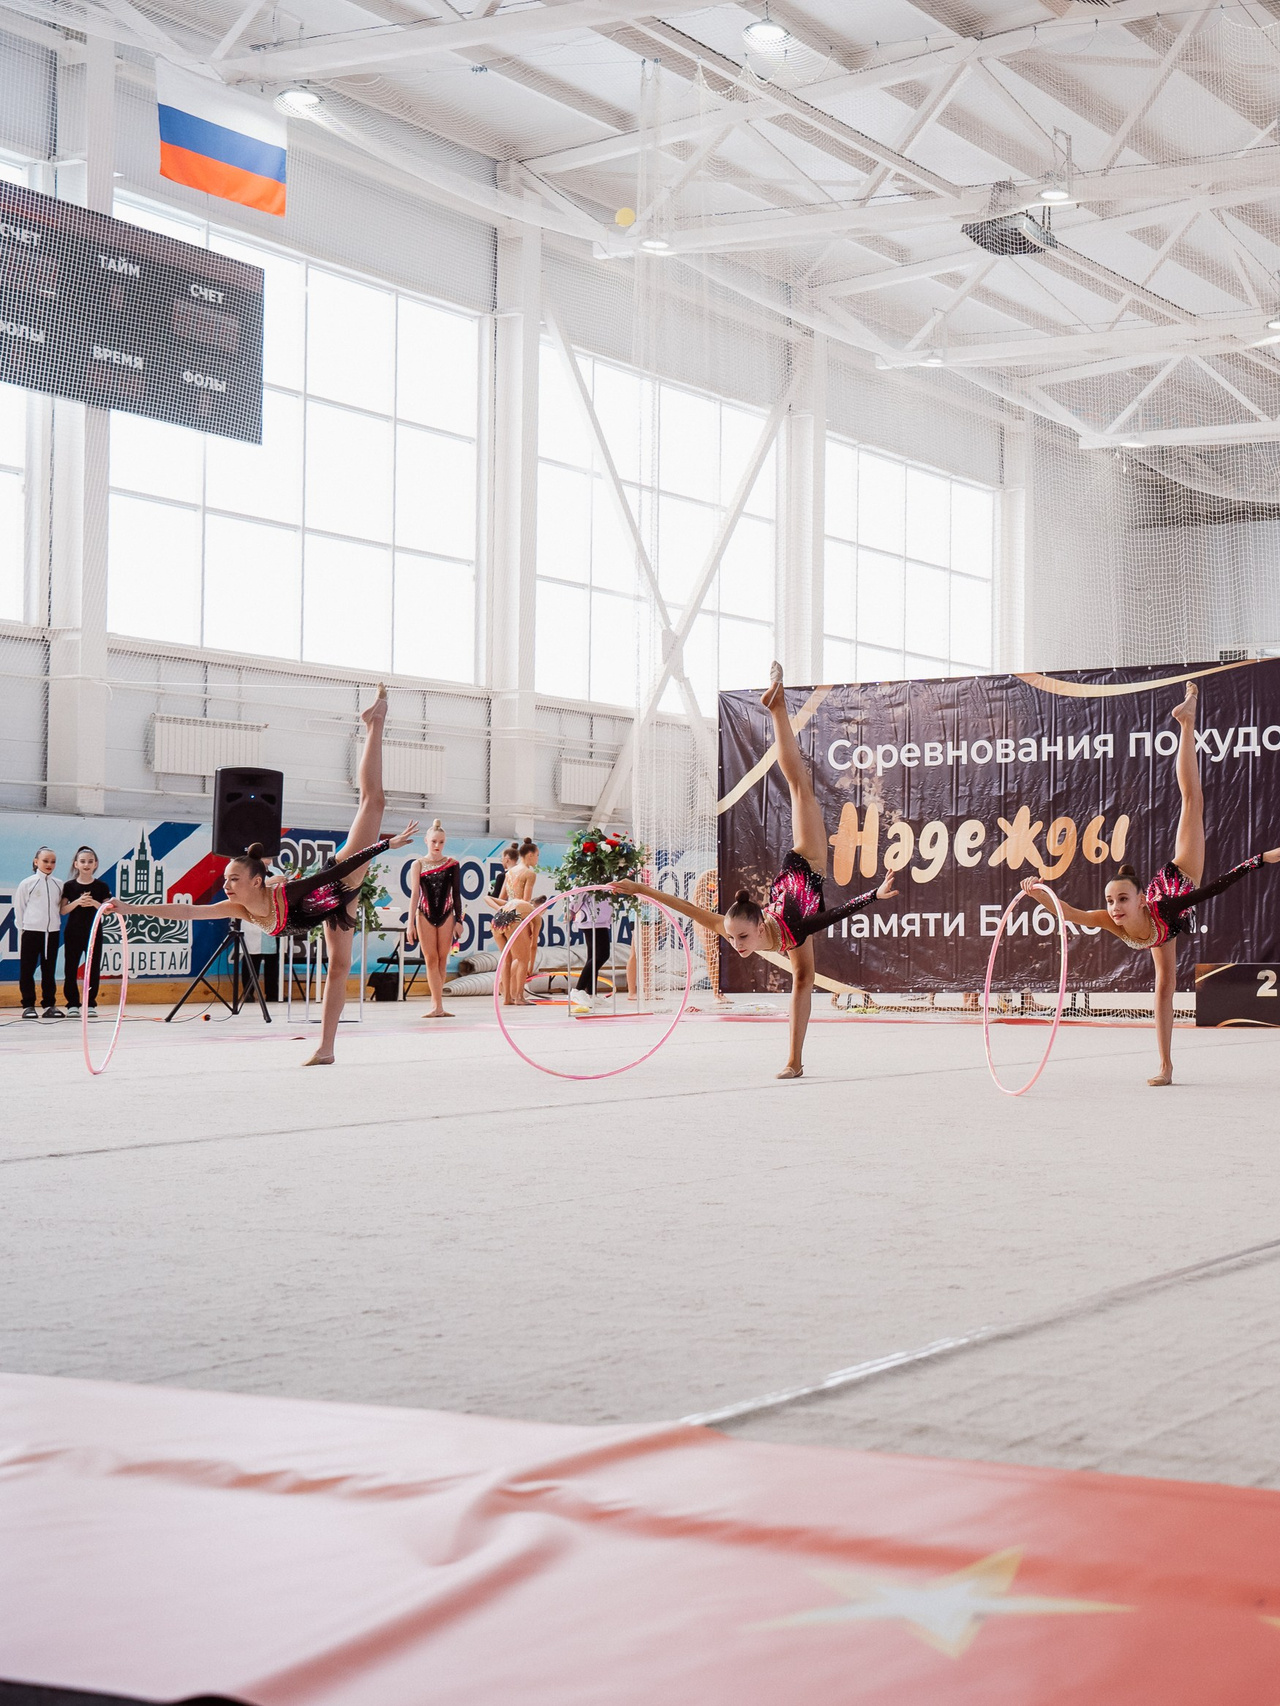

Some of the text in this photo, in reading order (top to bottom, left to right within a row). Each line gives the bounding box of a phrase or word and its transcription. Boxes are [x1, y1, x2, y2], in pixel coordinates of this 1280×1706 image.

[98, 254, 140, 278] ТАЙМ
[190, 284, 225, 304] СЧЕТ
[92, 345, 144, 371] ВРЕМЯ
[182, 370, 227, 393] ФОЛЫ
[827, 733, 1114, 776] Соревнования
[1129, 730, 1178, 757] по
[829, 801, 1130, 886] Надежды
[101, 947, 189, 974] АСЦВЕТАЙ
[1256, 970, 1278, 997] 2
